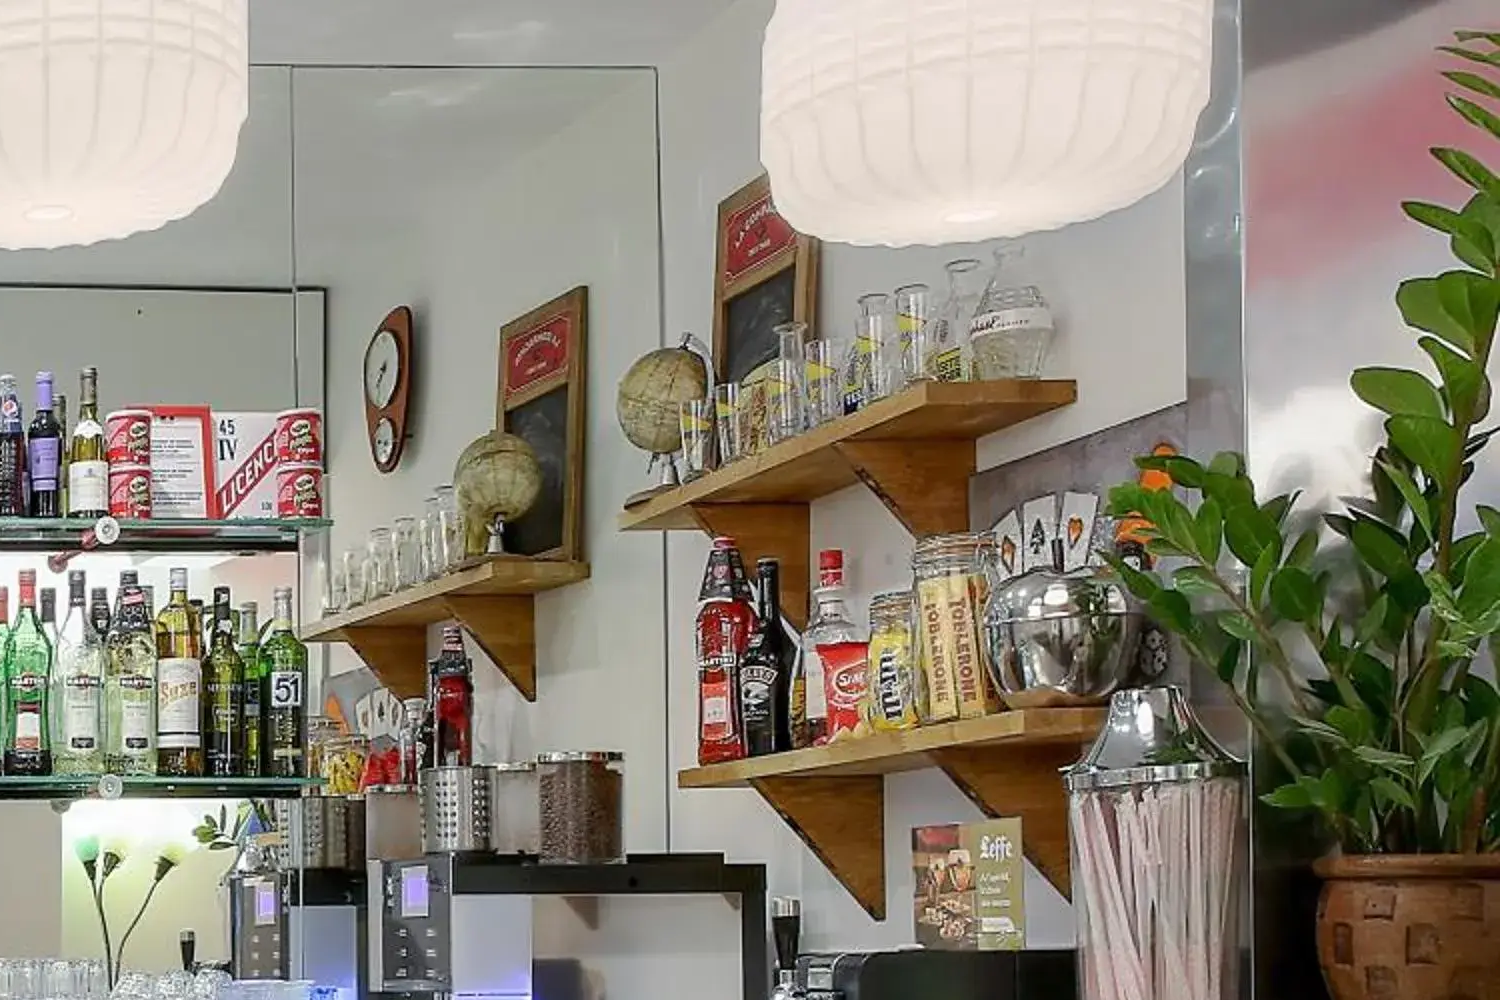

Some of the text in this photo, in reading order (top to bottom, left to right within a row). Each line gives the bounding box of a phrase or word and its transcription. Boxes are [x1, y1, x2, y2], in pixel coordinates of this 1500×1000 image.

[219, 418, 236, 436] 45
[218, 438, 239, 462] IV
[948, 598, 977, 702] TOBLERONE
[274, 675, 300, 704] 51
[979, 834, 1013, 863] Leffe
